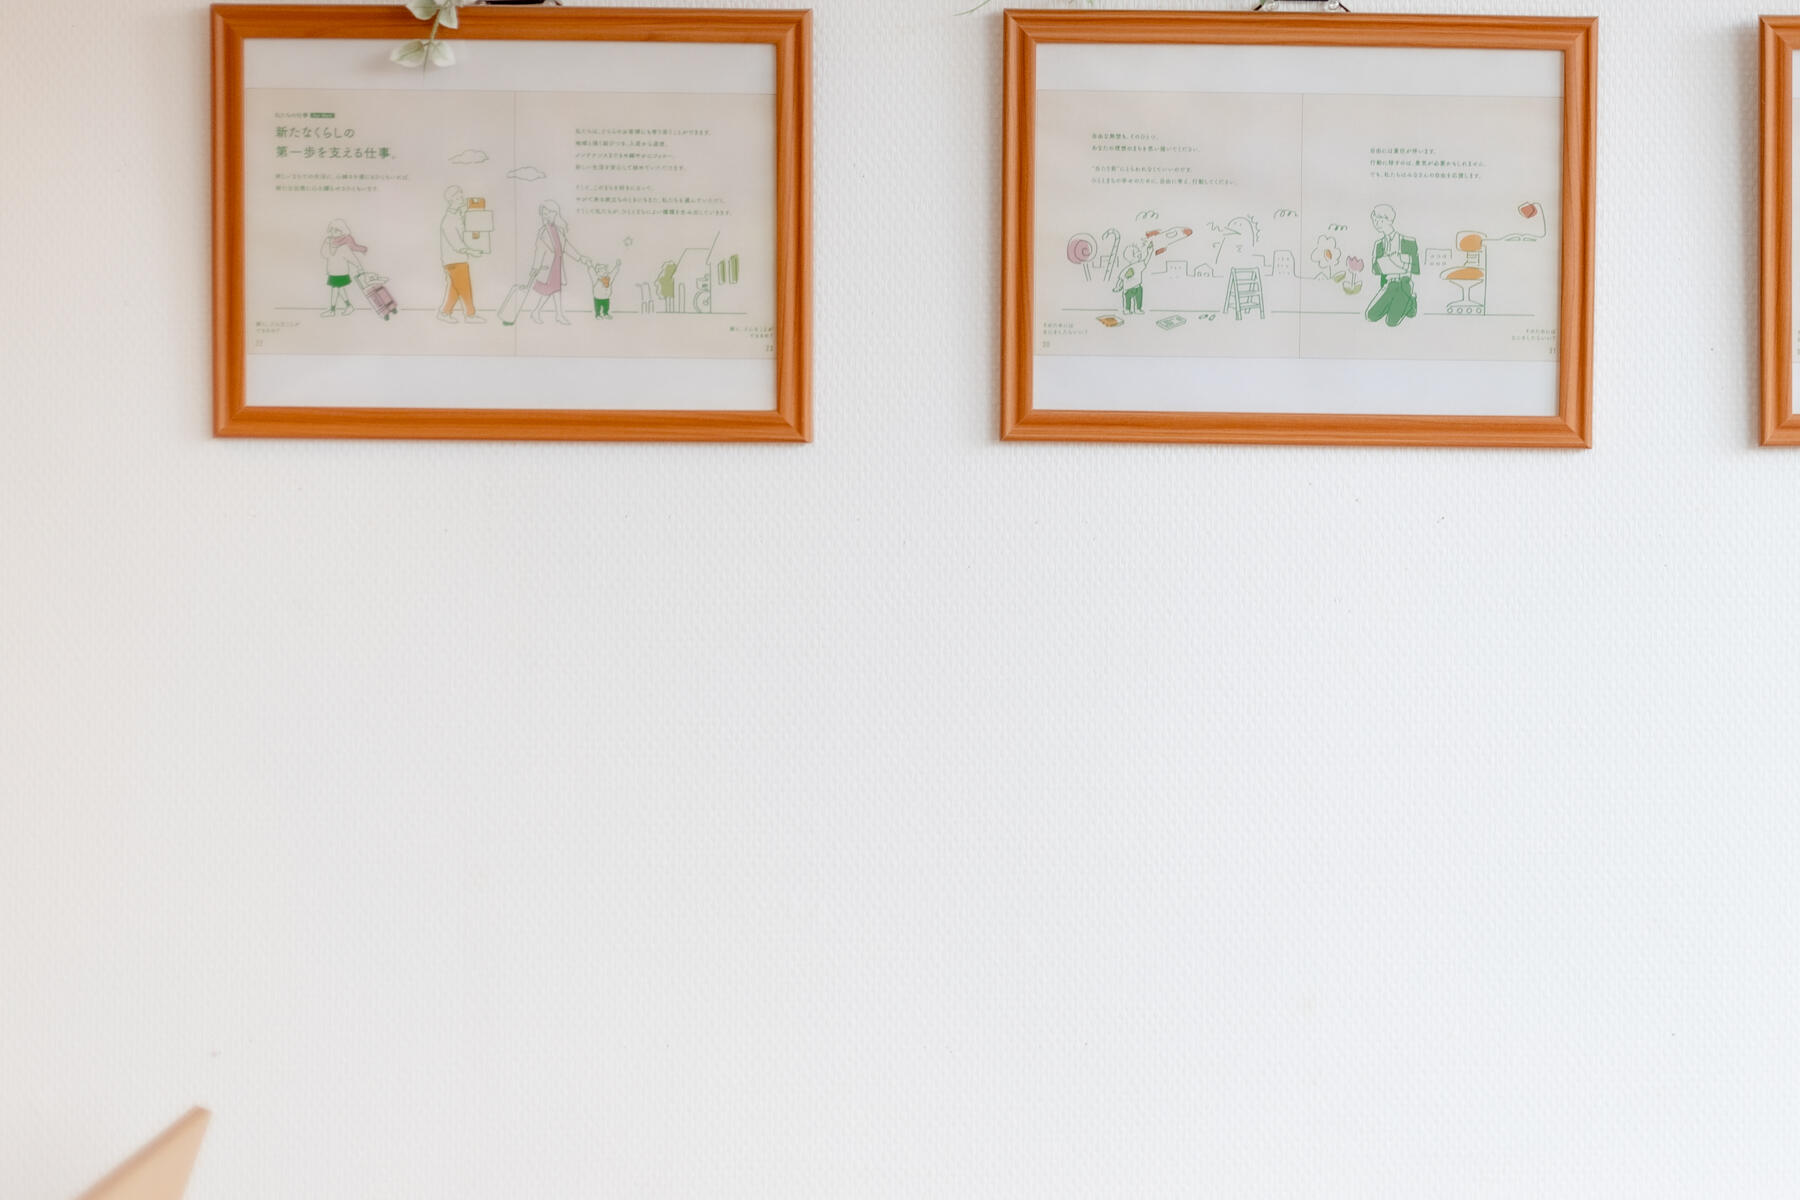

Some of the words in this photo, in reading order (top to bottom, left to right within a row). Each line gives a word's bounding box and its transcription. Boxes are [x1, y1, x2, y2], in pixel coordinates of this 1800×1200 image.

[275, 126, 356, 139] 新たなくらしの
[275, 145, 398, 161] 第一歩を支える仕事。
